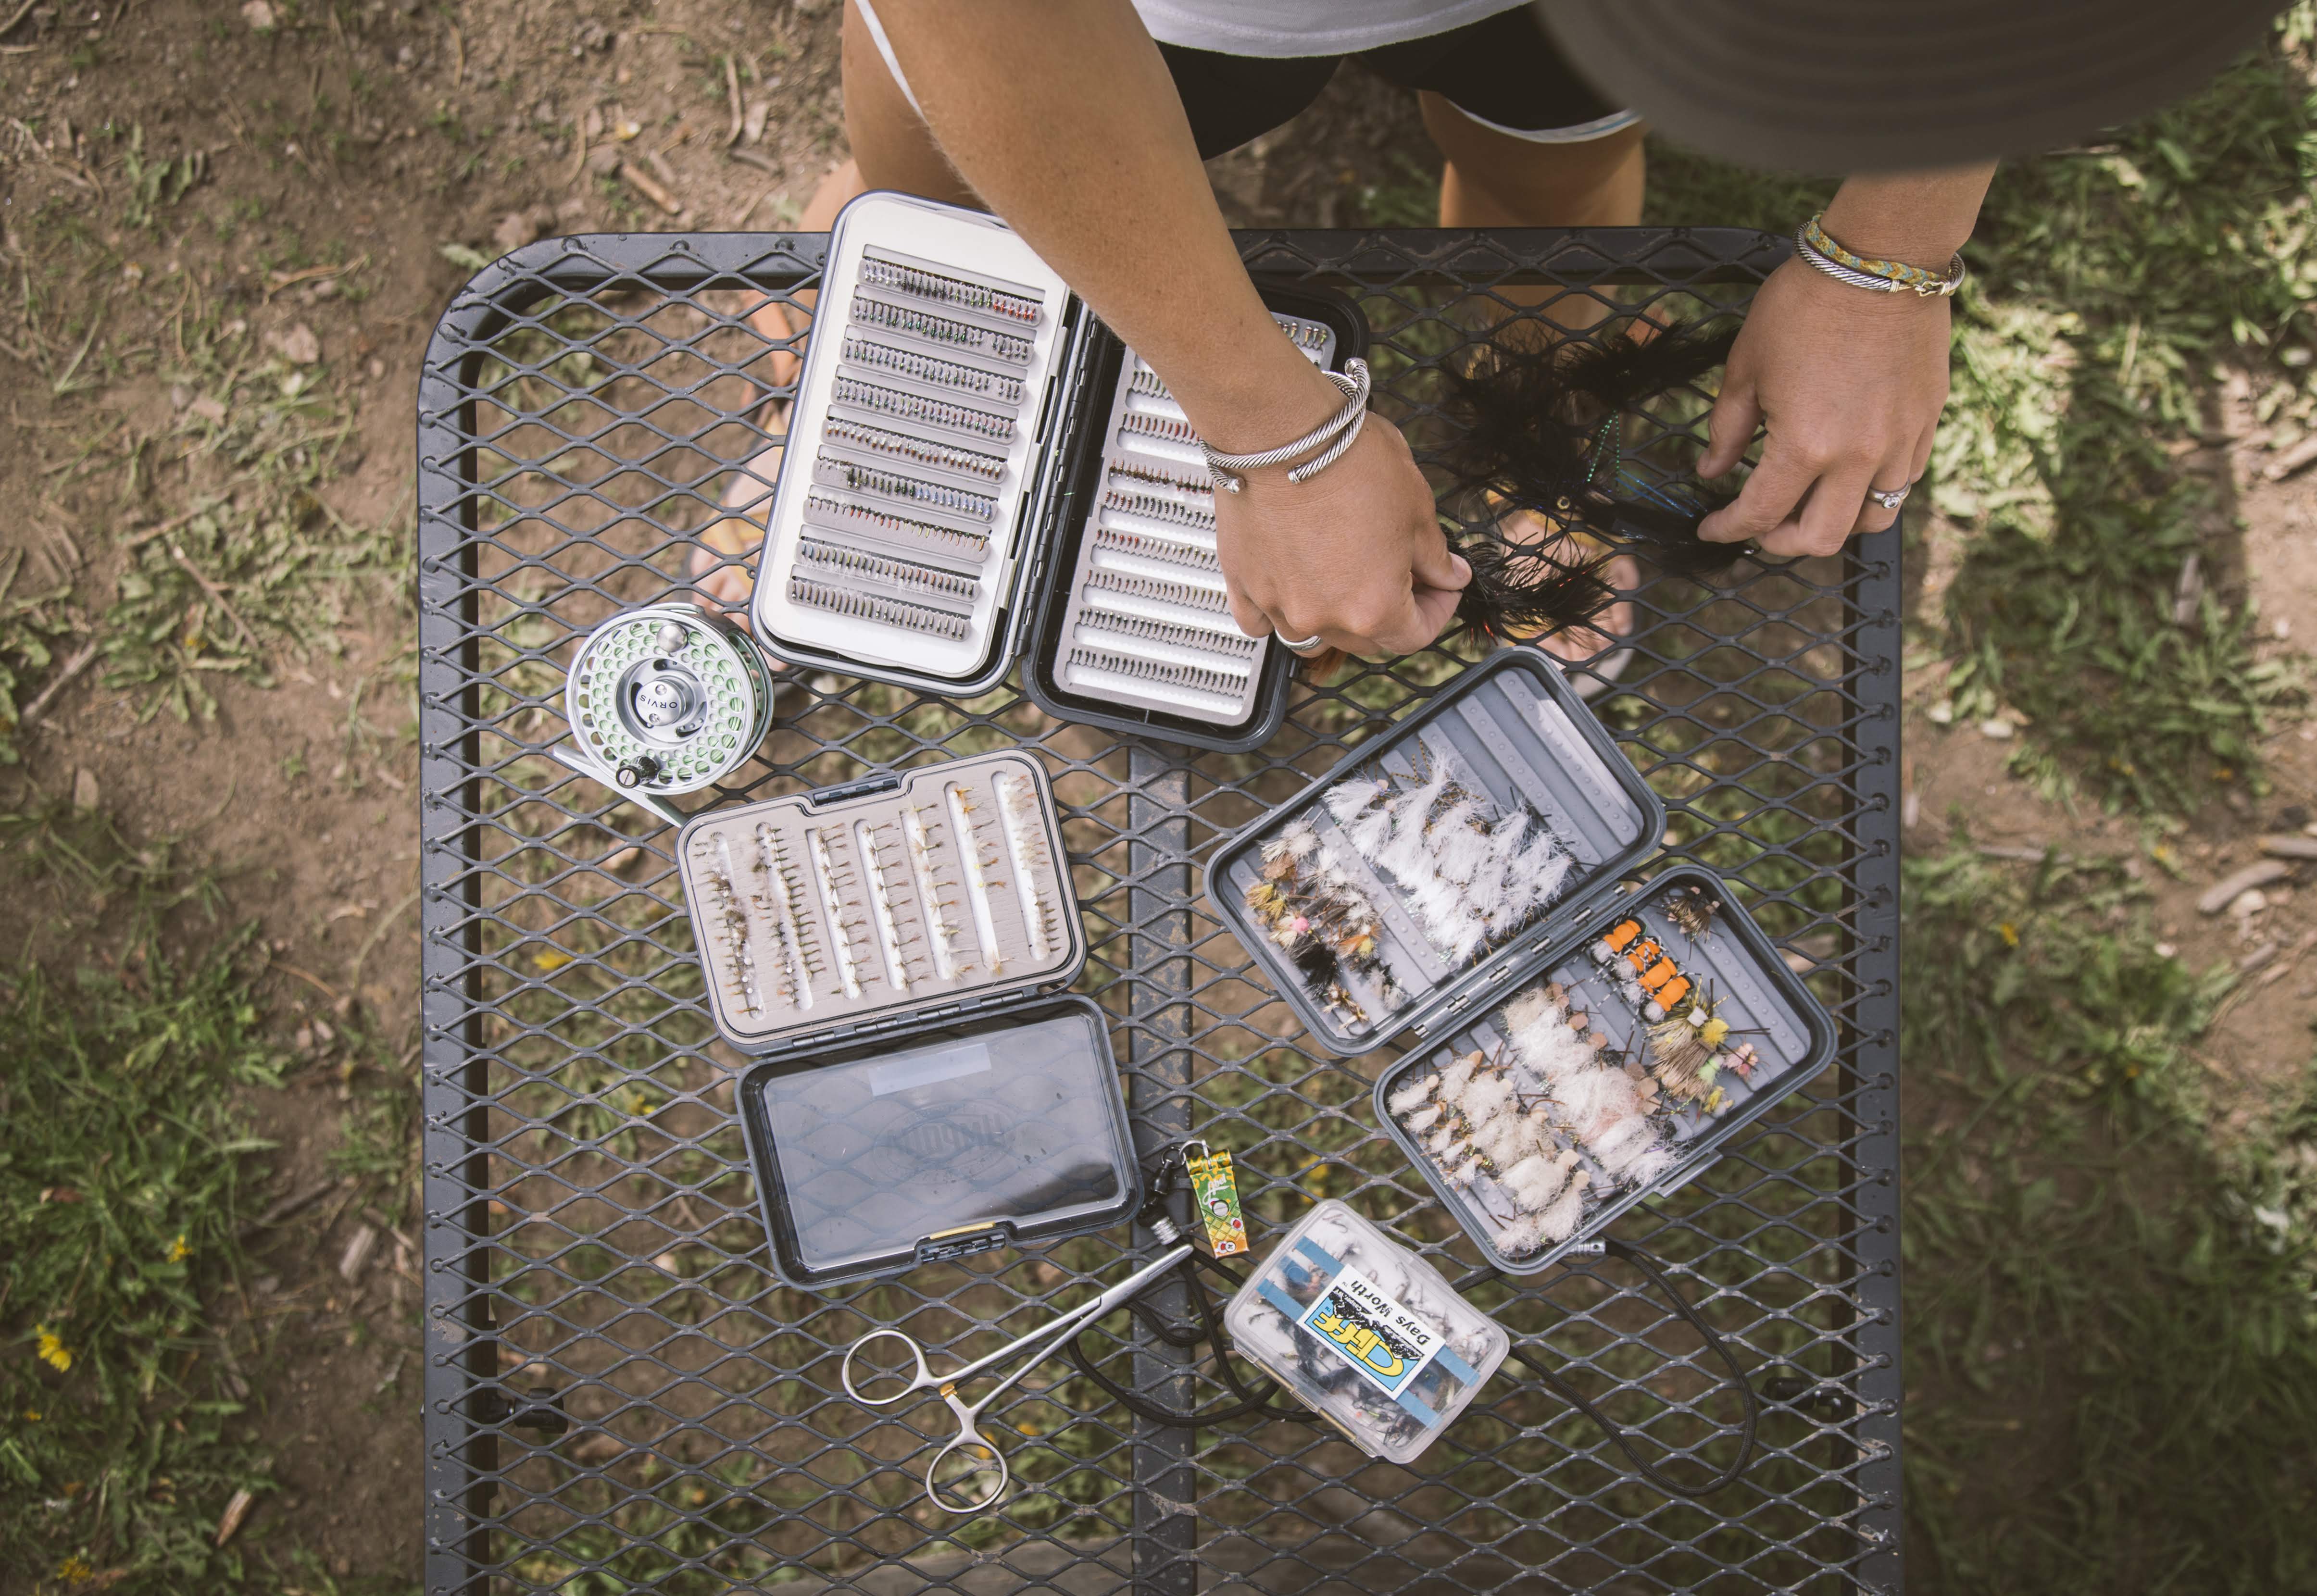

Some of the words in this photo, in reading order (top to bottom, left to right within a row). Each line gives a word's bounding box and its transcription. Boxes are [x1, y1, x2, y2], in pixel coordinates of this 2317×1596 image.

[640, 695, 677, 709] ORVIS
[1202, 1173, 1230, 1205] Abel
[1351, 1280, 1393, 1318] Worth
[1312, 1311, 1404, 1377] Cliff
[1395, 1316, 1431, 1346] Days
